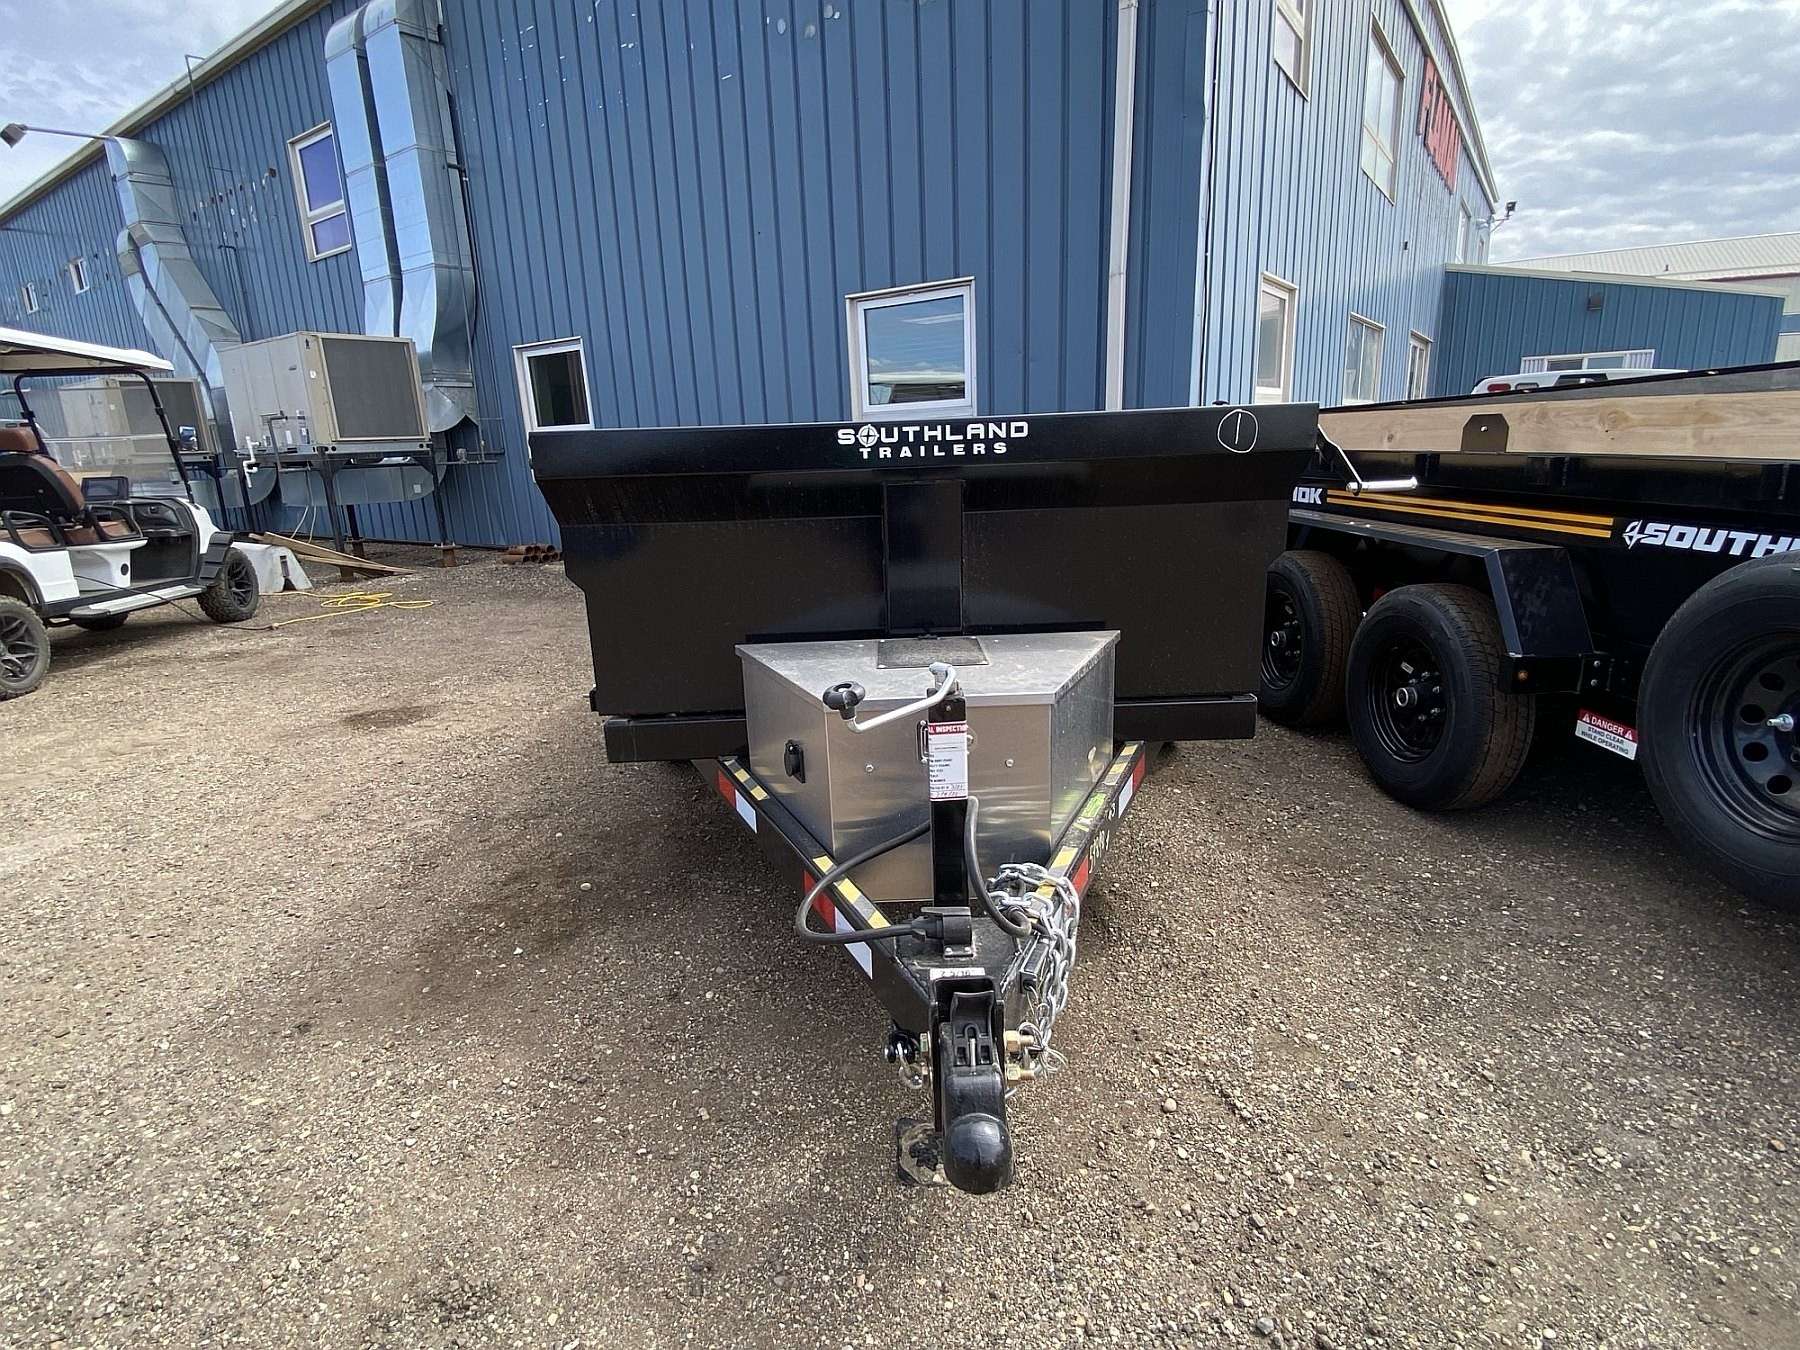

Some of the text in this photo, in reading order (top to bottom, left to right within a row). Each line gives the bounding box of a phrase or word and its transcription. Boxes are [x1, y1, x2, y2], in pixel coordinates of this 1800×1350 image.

[836, 421, 1029, 448] SOUTHLAND
[858, 441, 1008, 460] TRAILERS
[1591, 716, 1624, 736] DANGER
[1597, 737, 1629, 755] OPERATING
[1605, 733, 1624, 745] CLEAR
